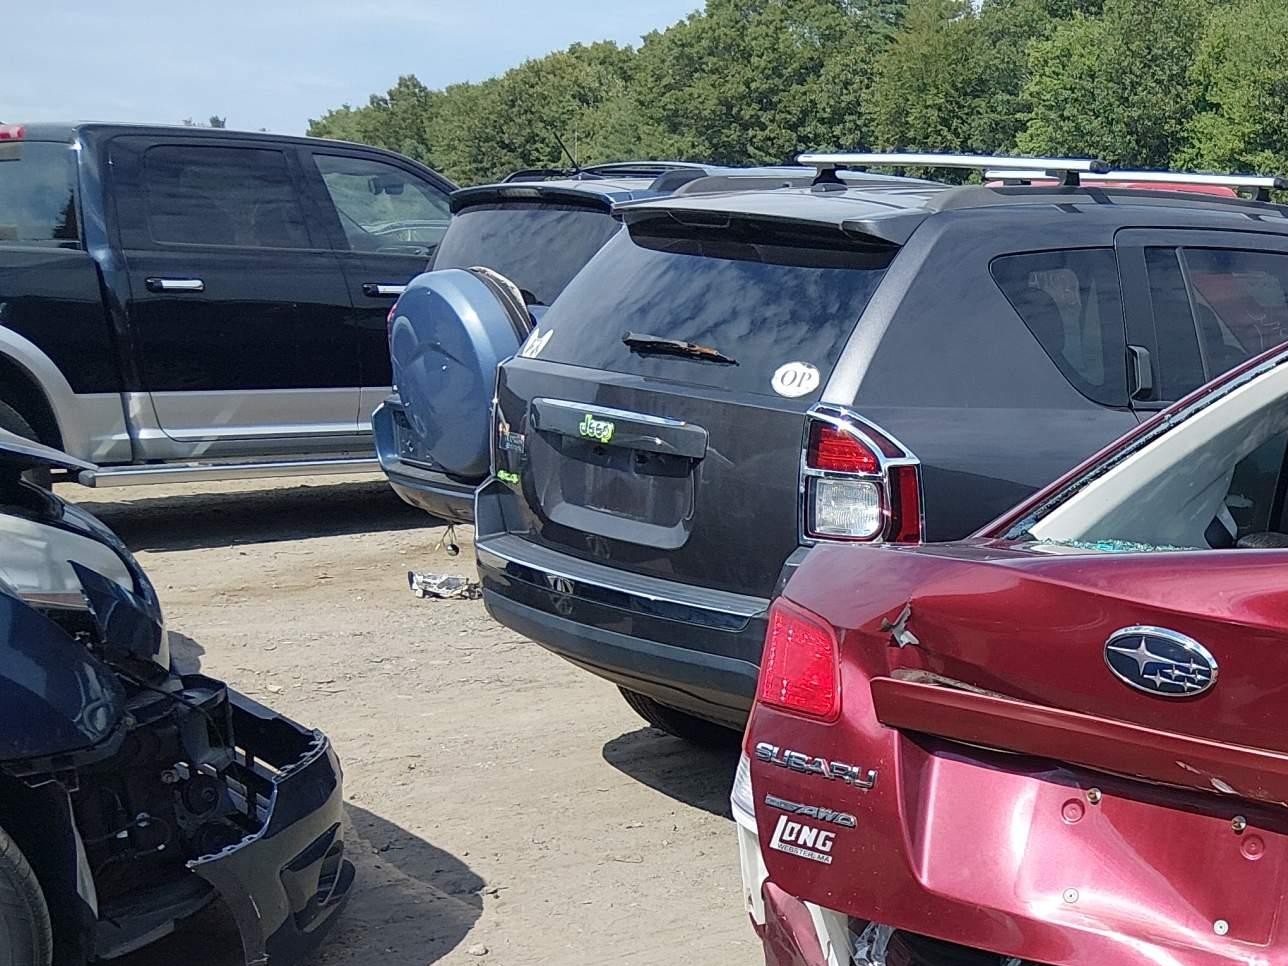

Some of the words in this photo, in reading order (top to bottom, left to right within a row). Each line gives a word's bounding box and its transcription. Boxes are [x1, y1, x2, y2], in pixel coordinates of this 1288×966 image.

[780, 369, 813, 388] OP
[579, 414, 614, 443] Jeep
[756, 742, 878, 789] SUBARU
[795, 804, 858, 828] AWD
[769, 815, 836, 852] LONG
[817, 854, 830, 863] MA
